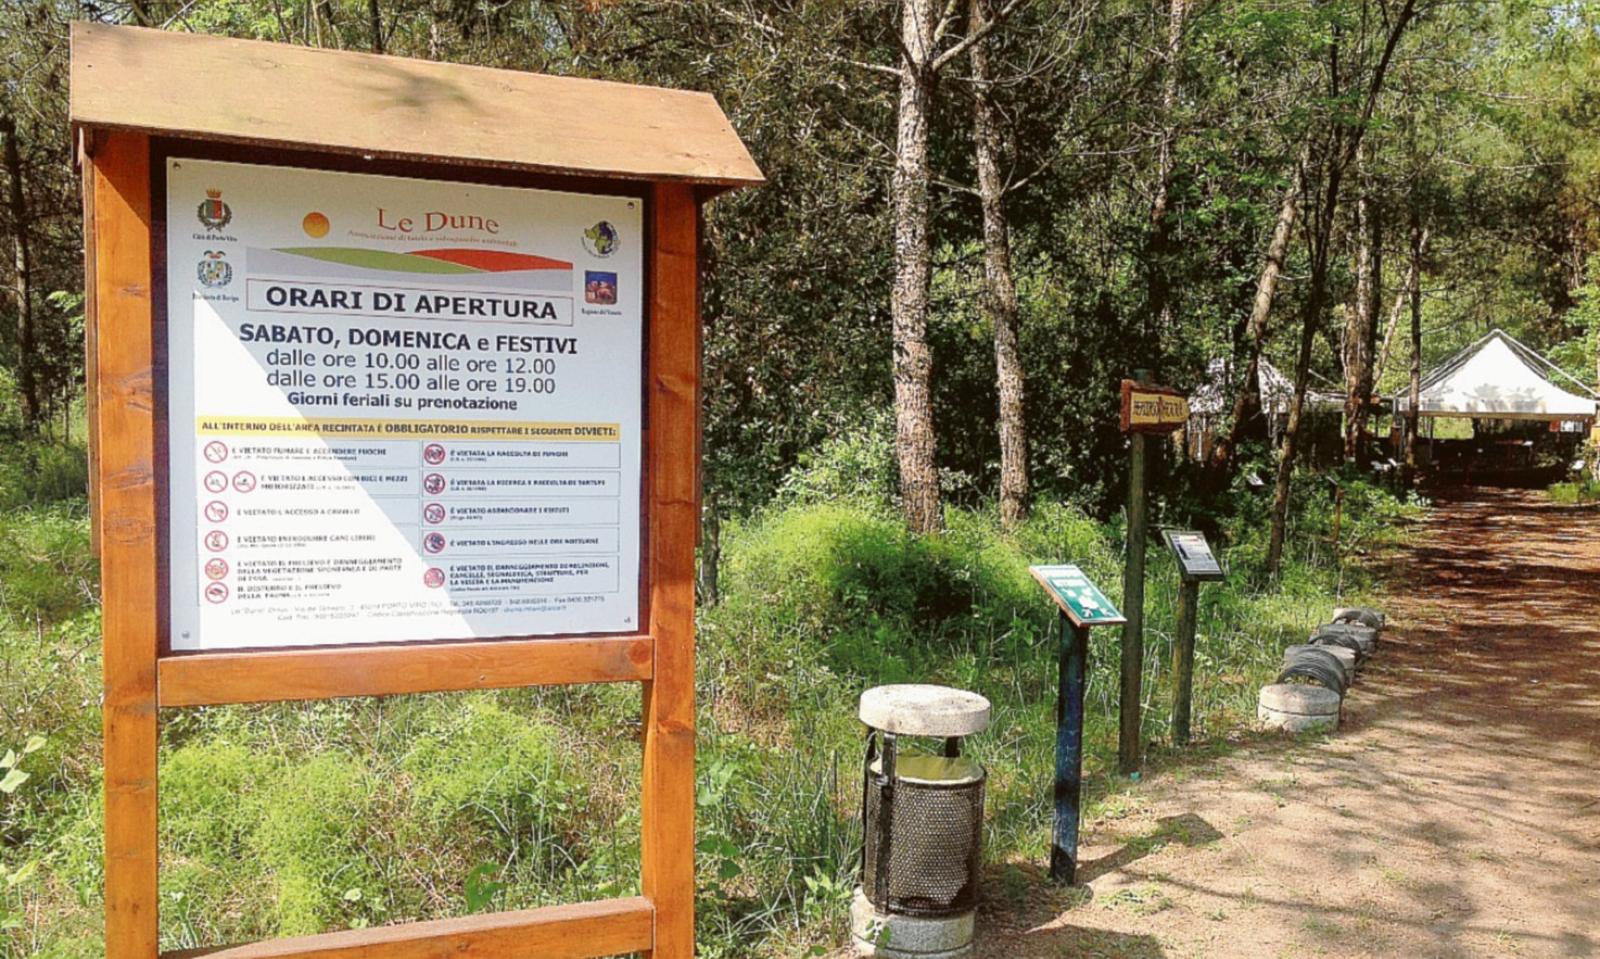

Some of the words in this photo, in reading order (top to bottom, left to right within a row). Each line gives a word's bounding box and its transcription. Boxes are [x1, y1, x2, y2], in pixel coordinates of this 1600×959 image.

[376, 207, 413, 232] Le
[425, 211, 500, 234] Dune
[266, 286, 363, 309] ORARI
[373, 292, 406, 312] DI
[415, 295, 557, 320] APERTURA
[239, 323, 341, 348] SABATO,
[349, 328, 471, 351] DOMENICA
[477, 337, 489, 351] e
[496, 335, 577, 354] FESTIVI
[266, 349, 316, 366] dalle
[323, 354, 356, 368] ore
[365, 352, 420, 370] 10.00
[426, 354, 460, 372] alle
[467, 358, 497, 373] ore
[505, 358, 556, 374] 12.00
[266, 370, 316, 387] dalle
[323, 374, 356, 388] ore
[365, 373, 420, 390] 15.00
[426, 374, 460, 391] alle
[467, 378, 497, 392] ore
[505, 378, 556, 394] 19.00
[287, 391, 338, 406] Giorni
[343, 392, 390, 407] feriali
[394, 396, 412, 408] su
[418, 396, 518, 411] prenotazione
[202, 421, 267, 431] ALL'INTERNO
[269, 422, 320, 432] DELL'AREA
[322, 423, 375, 433] RECINTATA
[385, 423, 469, 434] OBBLIGATORIO
[470, 426, 523, 435] RISPETTARE
[530, 427, 573, 436] SEGUENTI
[574, 426, 617, 437] DIVIETI:
